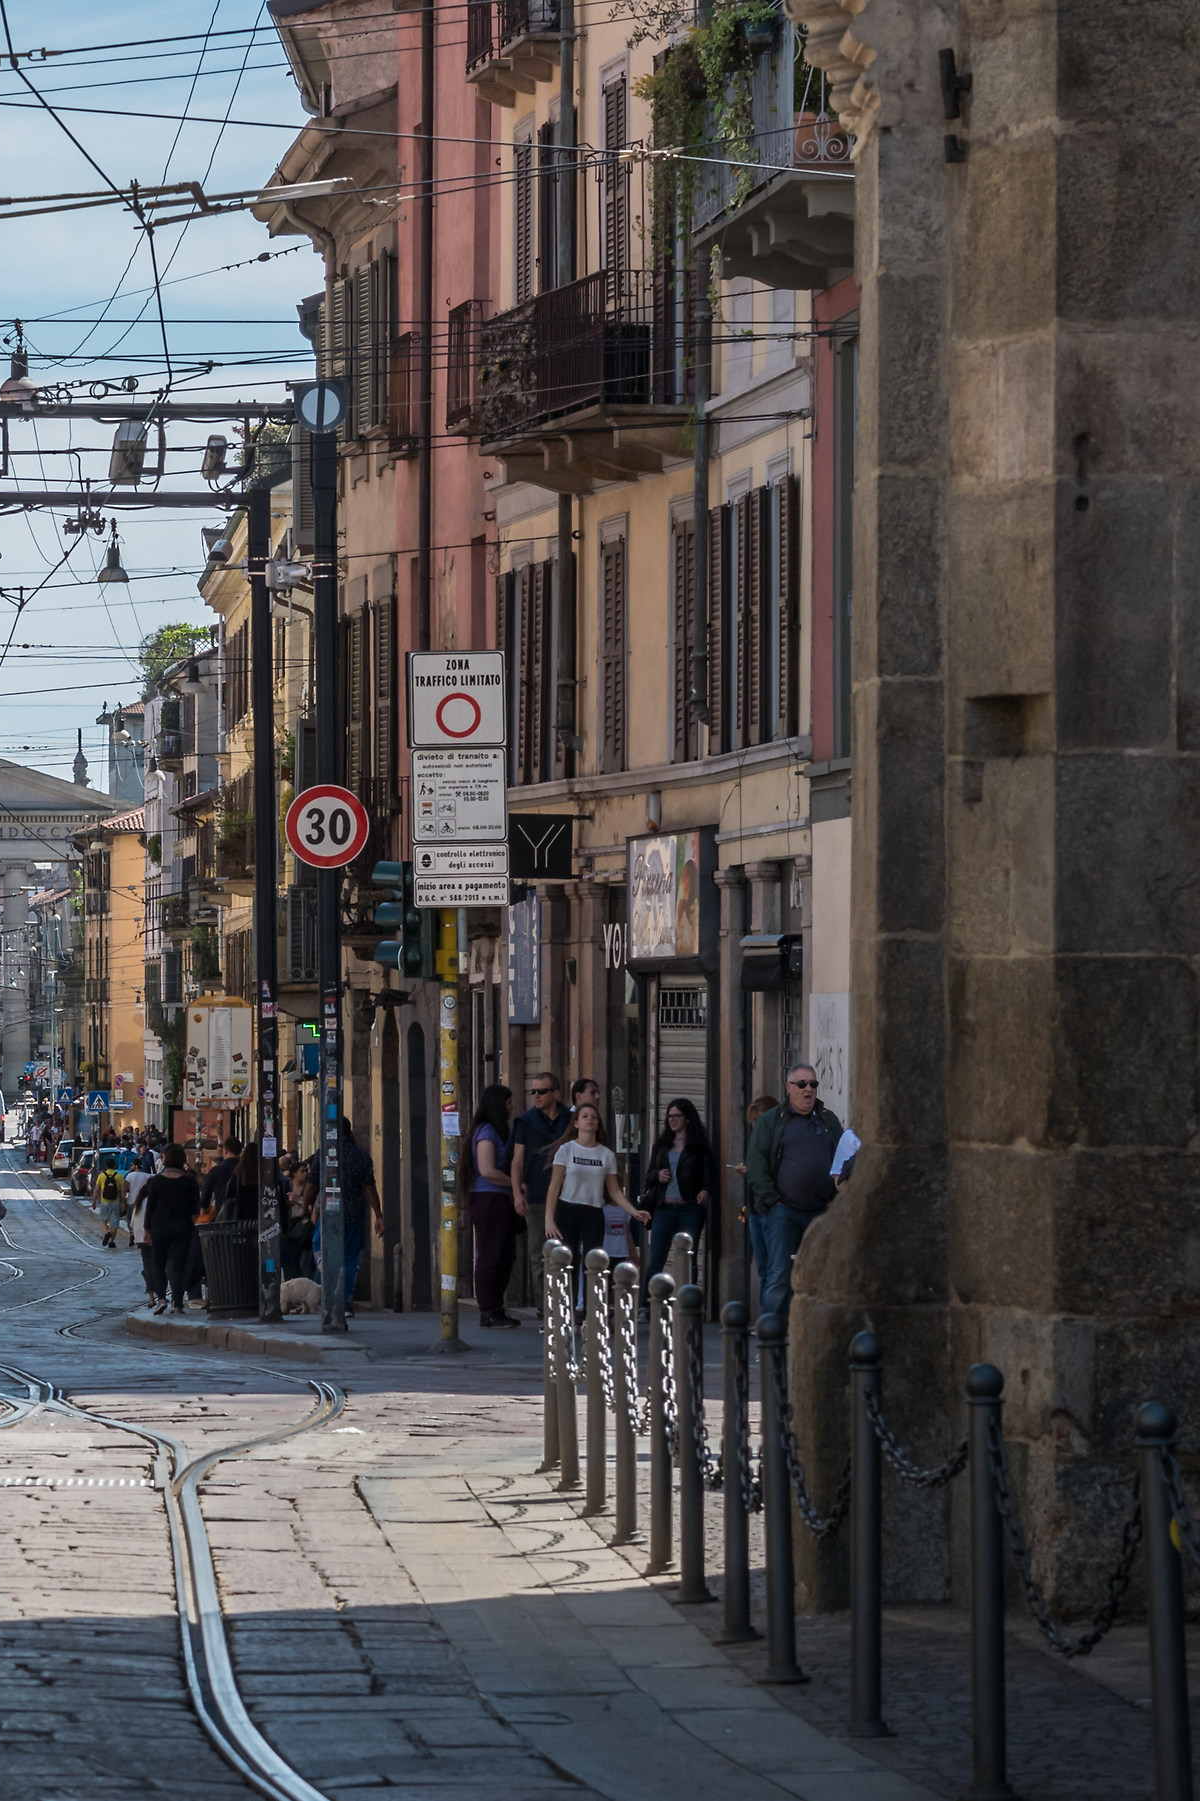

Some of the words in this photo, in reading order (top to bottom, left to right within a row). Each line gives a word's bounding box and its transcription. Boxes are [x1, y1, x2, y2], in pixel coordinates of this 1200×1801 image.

[446, 659, 470, 671] ZONA
[415, 675, 458, 687] TRAFFICO
[460, 674, 501, 686] LIMITATO
[417, 753, 444, 761] divieto
[457, 752, 489, 760] transito
[305, 808, 351, 846] 30
[469, 849, 506, 858] elettronico
[448, 861, 466, 870] degli
[417, 881, 437, 891] inizio
[464, 881, 506, 892] pagamento
[418, 894, 438, 902] D.G.C.
